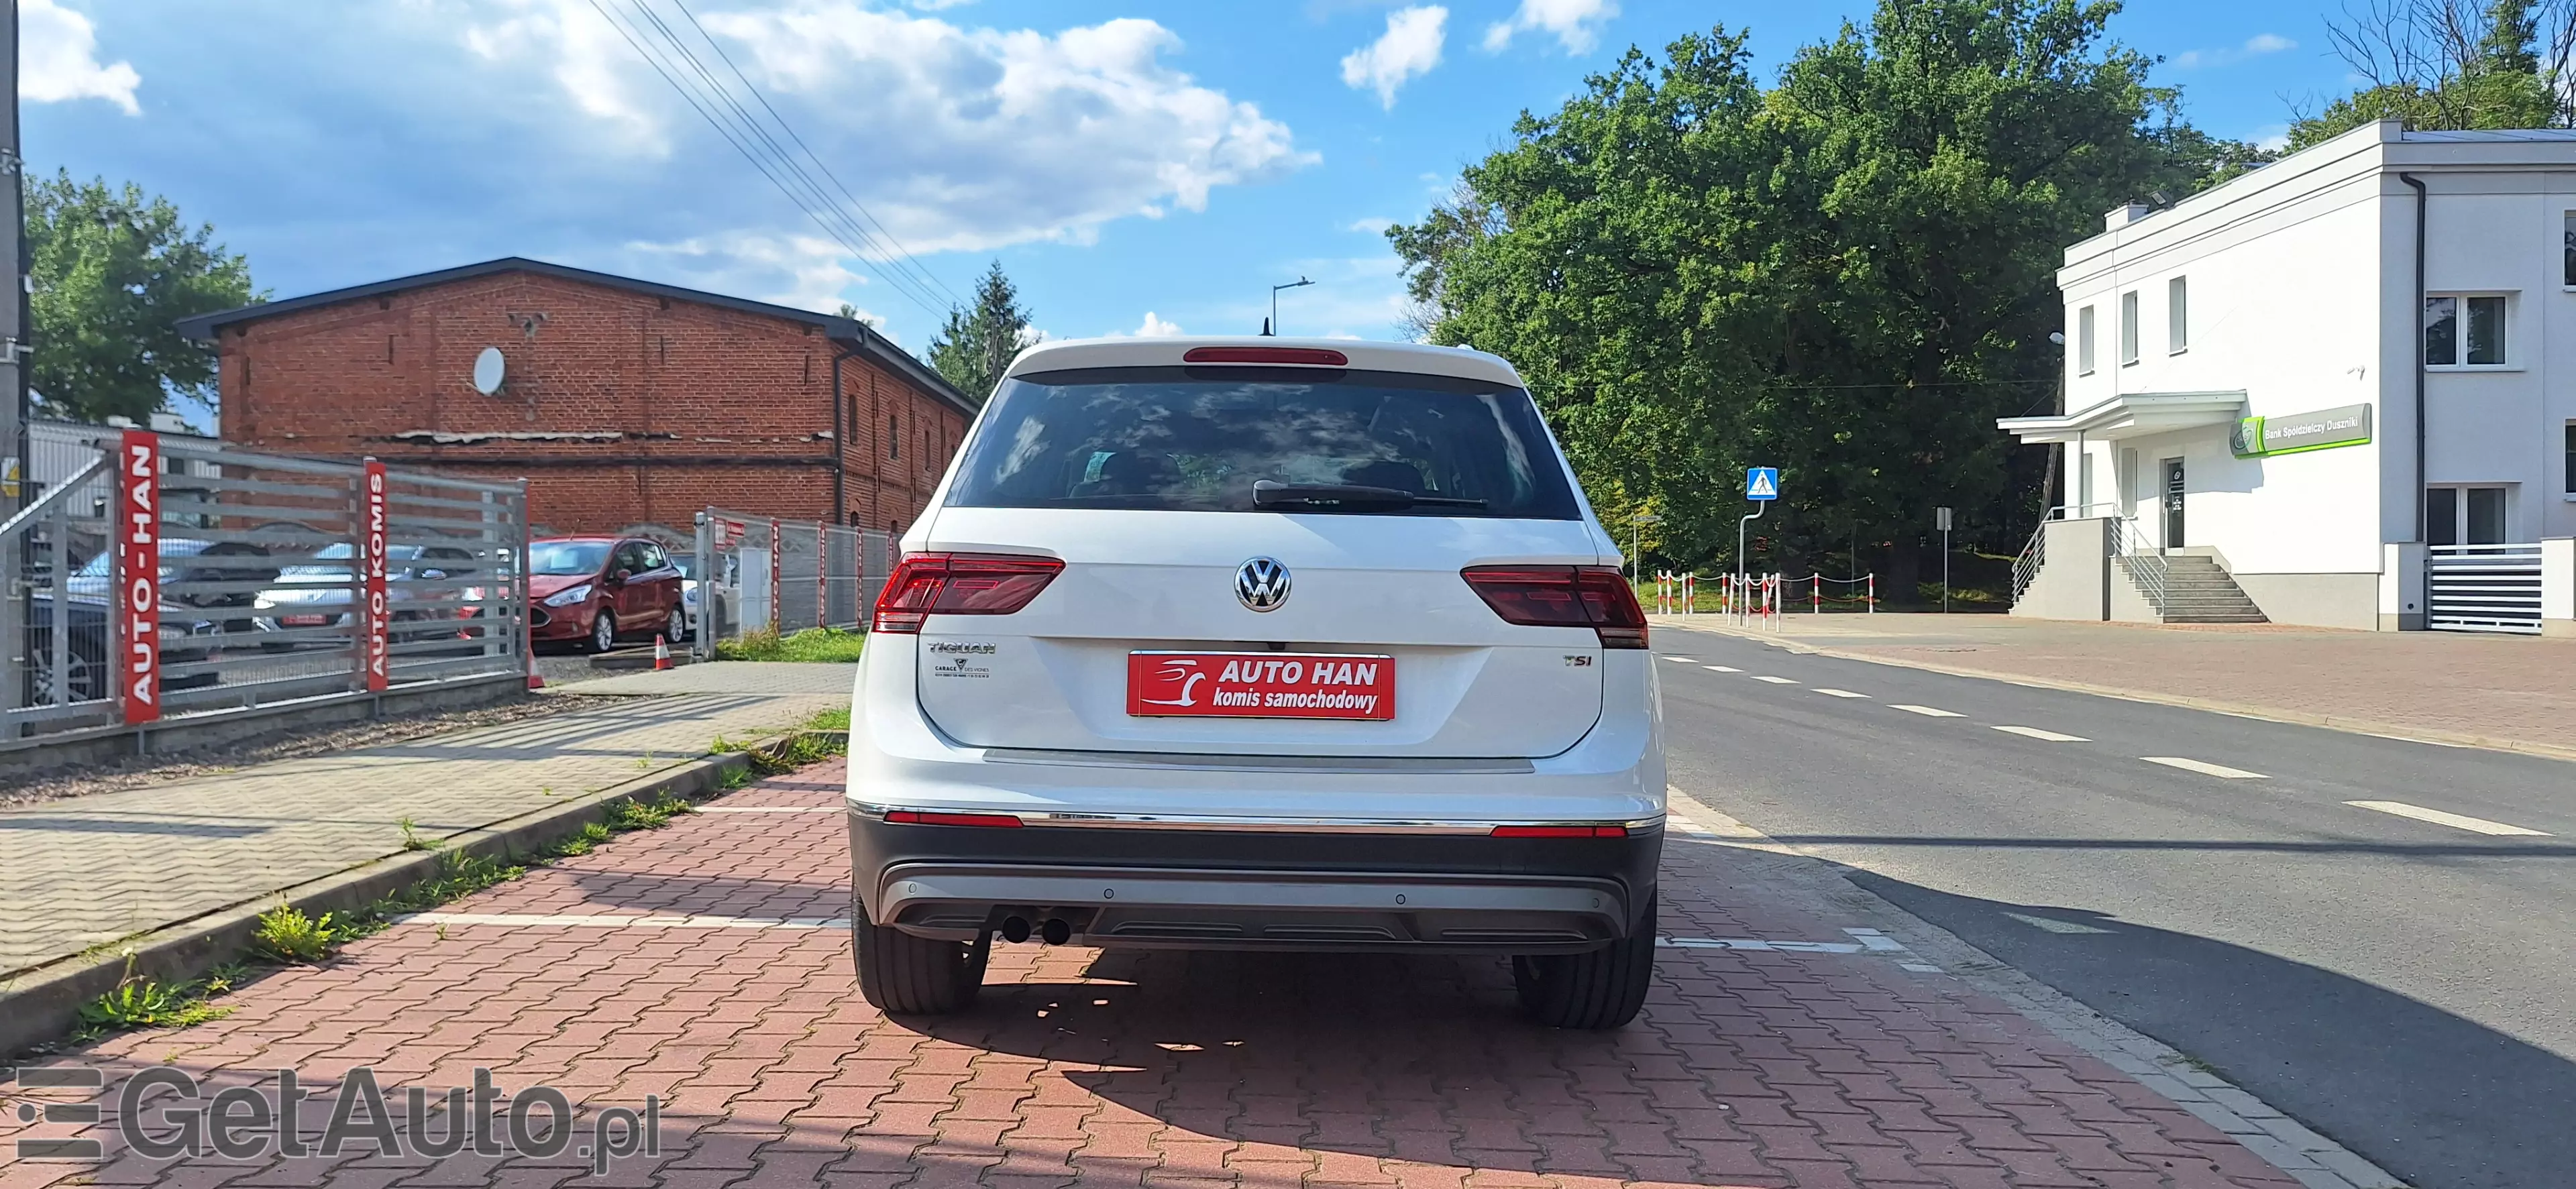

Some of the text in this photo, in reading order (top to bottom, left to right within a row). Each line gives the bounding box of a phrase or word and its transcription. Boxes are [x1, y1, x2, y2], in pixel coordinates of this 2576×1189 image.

[2265, 429, 2282, 440] Bank
[2326, 416, 2359, 431] Duszniki
[370, 473, 384, 677] AUTO KOMIS
[927, 642, 996, 655] TIGUAN
[1218, 661, 1378, 685] AUTO HAN
[1562, 655, 1592, 667] TSI
[1213, 687, 1379, 714] komis samochodowy
